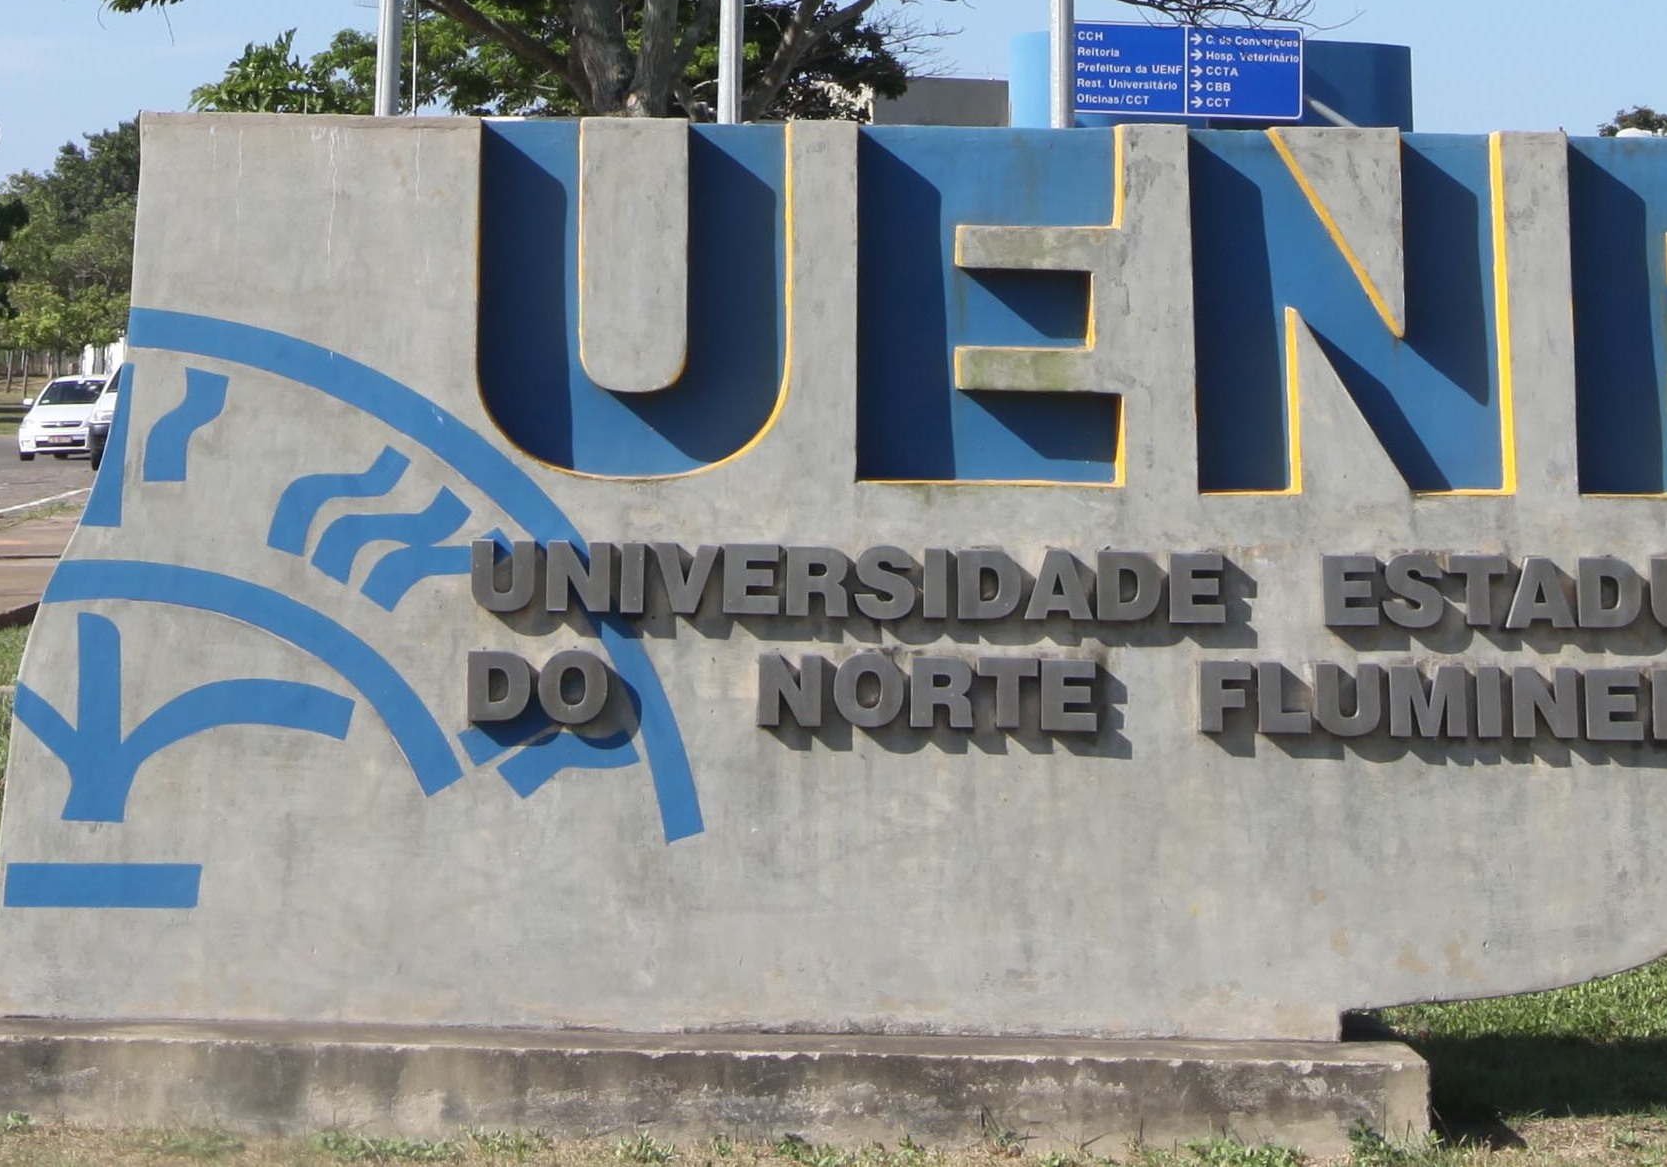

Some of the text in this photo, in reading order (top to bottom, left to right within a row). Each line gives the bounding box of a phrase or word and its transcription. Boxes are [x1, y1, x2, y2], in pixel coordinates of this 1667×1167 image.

[1077, 31, 1104, 41] CCH
[1077, 46, 1120, 57] Reitoria
[1205, 50, 1300, 63] Hosp. Veterinário
[1077, 62, 1183, 74] Prefeitura da UENF
[1205, 65, 1239, 77] CCTA
[1076, 78, 1178, 90] Rest. Universitário
[1205, 82, 1231, 92] CBB
[1076, 93, 1150, 105] Oficinas/CCT
[1205, 97, 1231, 108] CCT
[472, 537, 1228, 627] UNIVERSIDADE
[467, 649, 608, 726] DO
[757, 653, 1098, 734] NORTE
